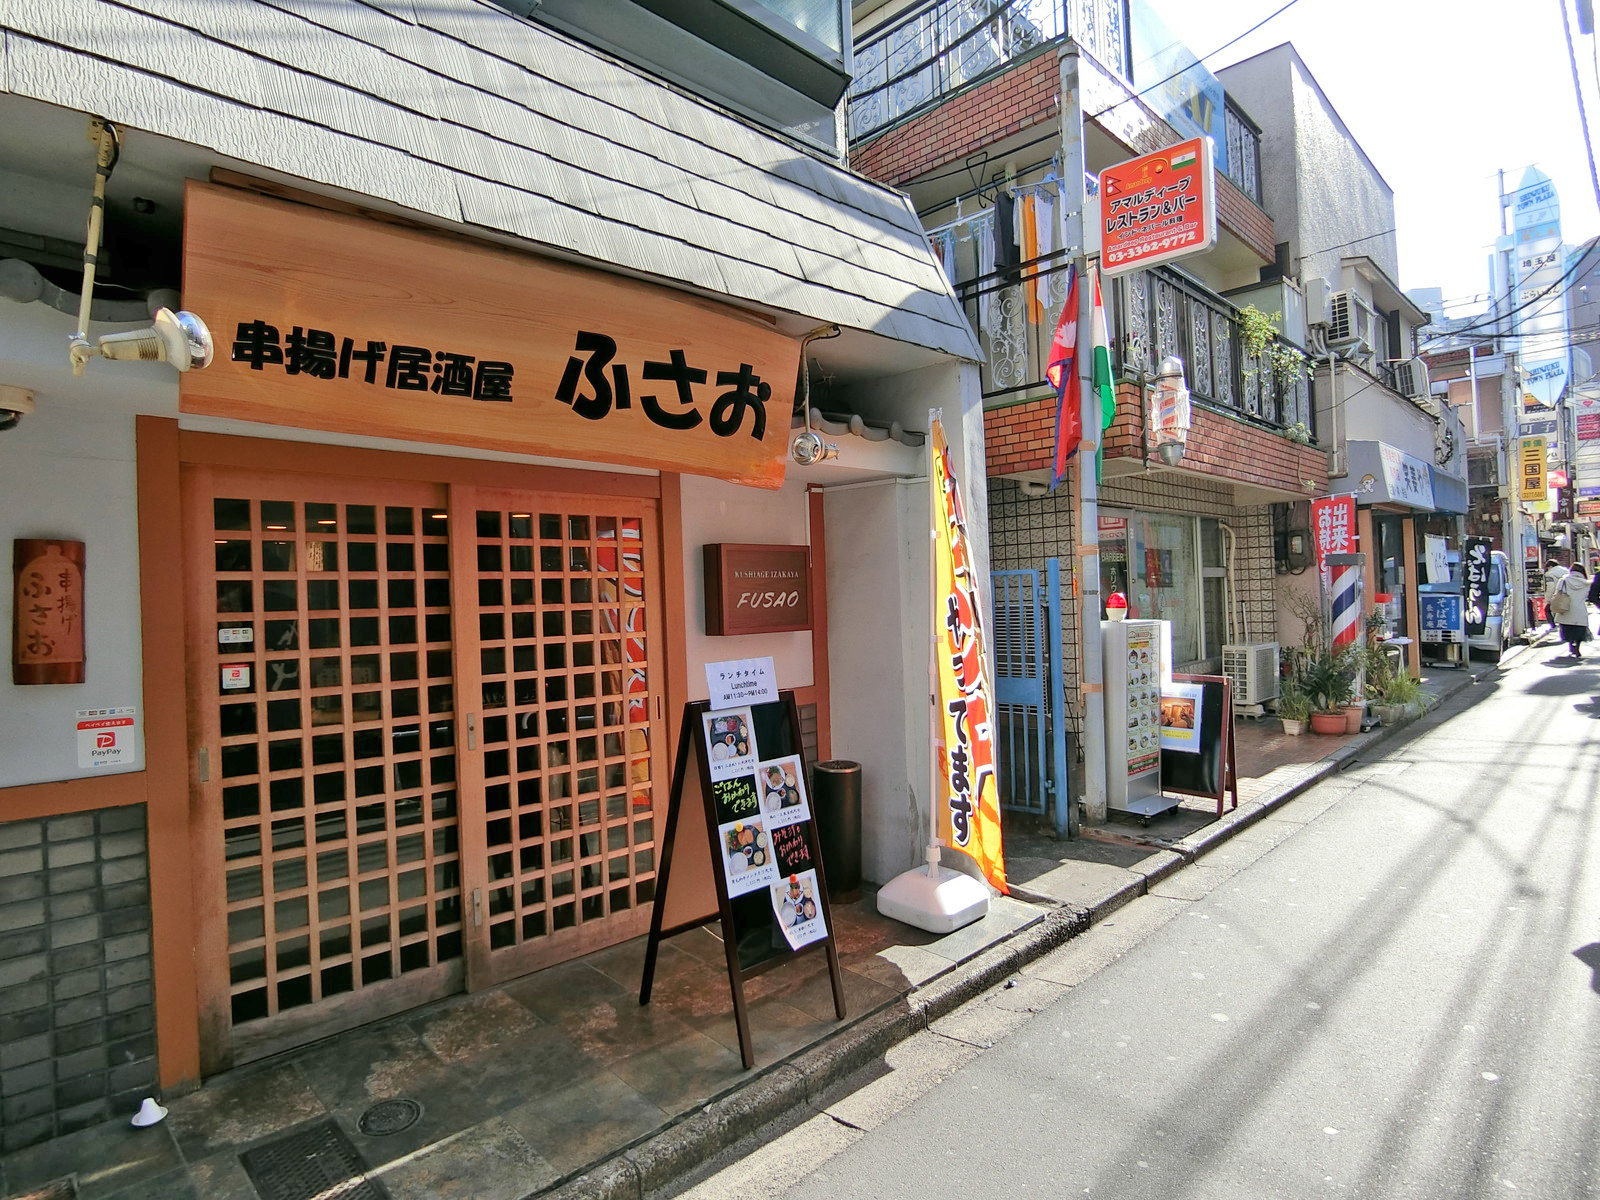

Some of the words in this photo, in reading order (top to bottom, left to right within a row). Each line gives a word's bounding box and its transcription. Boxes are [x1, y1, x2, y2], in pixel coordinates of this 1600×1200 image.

[1110, 176, 1191, 213] アマルディープ
[1107, 238, 1139, 253] Amardeep
[1139, 227, 1176, 244] Restaurant
[1184, 221, 1198, 231] Bar
[1108, 231, 1196, 262] 03-3362-9772
[232, 319, 513, 403] 串揚げ居酒屋
[555, 330, 772, 441] ふさお
[1524, 450, 1542, 490] 三国屋
[734, 570, 770, 578] KUSHIAGE
[770, 570, 799, 578] IZAKAYA
[23, 572, 55, 656] ふさお
[57, 569, 78, 635] 串揚げ
[737, 590, 799, 609] FUSAO
[719, 668, 765, 680] ランチタイム
[731, 679, 758, 690] Lunchtime
[91, 749, 121, 757] PayPay
